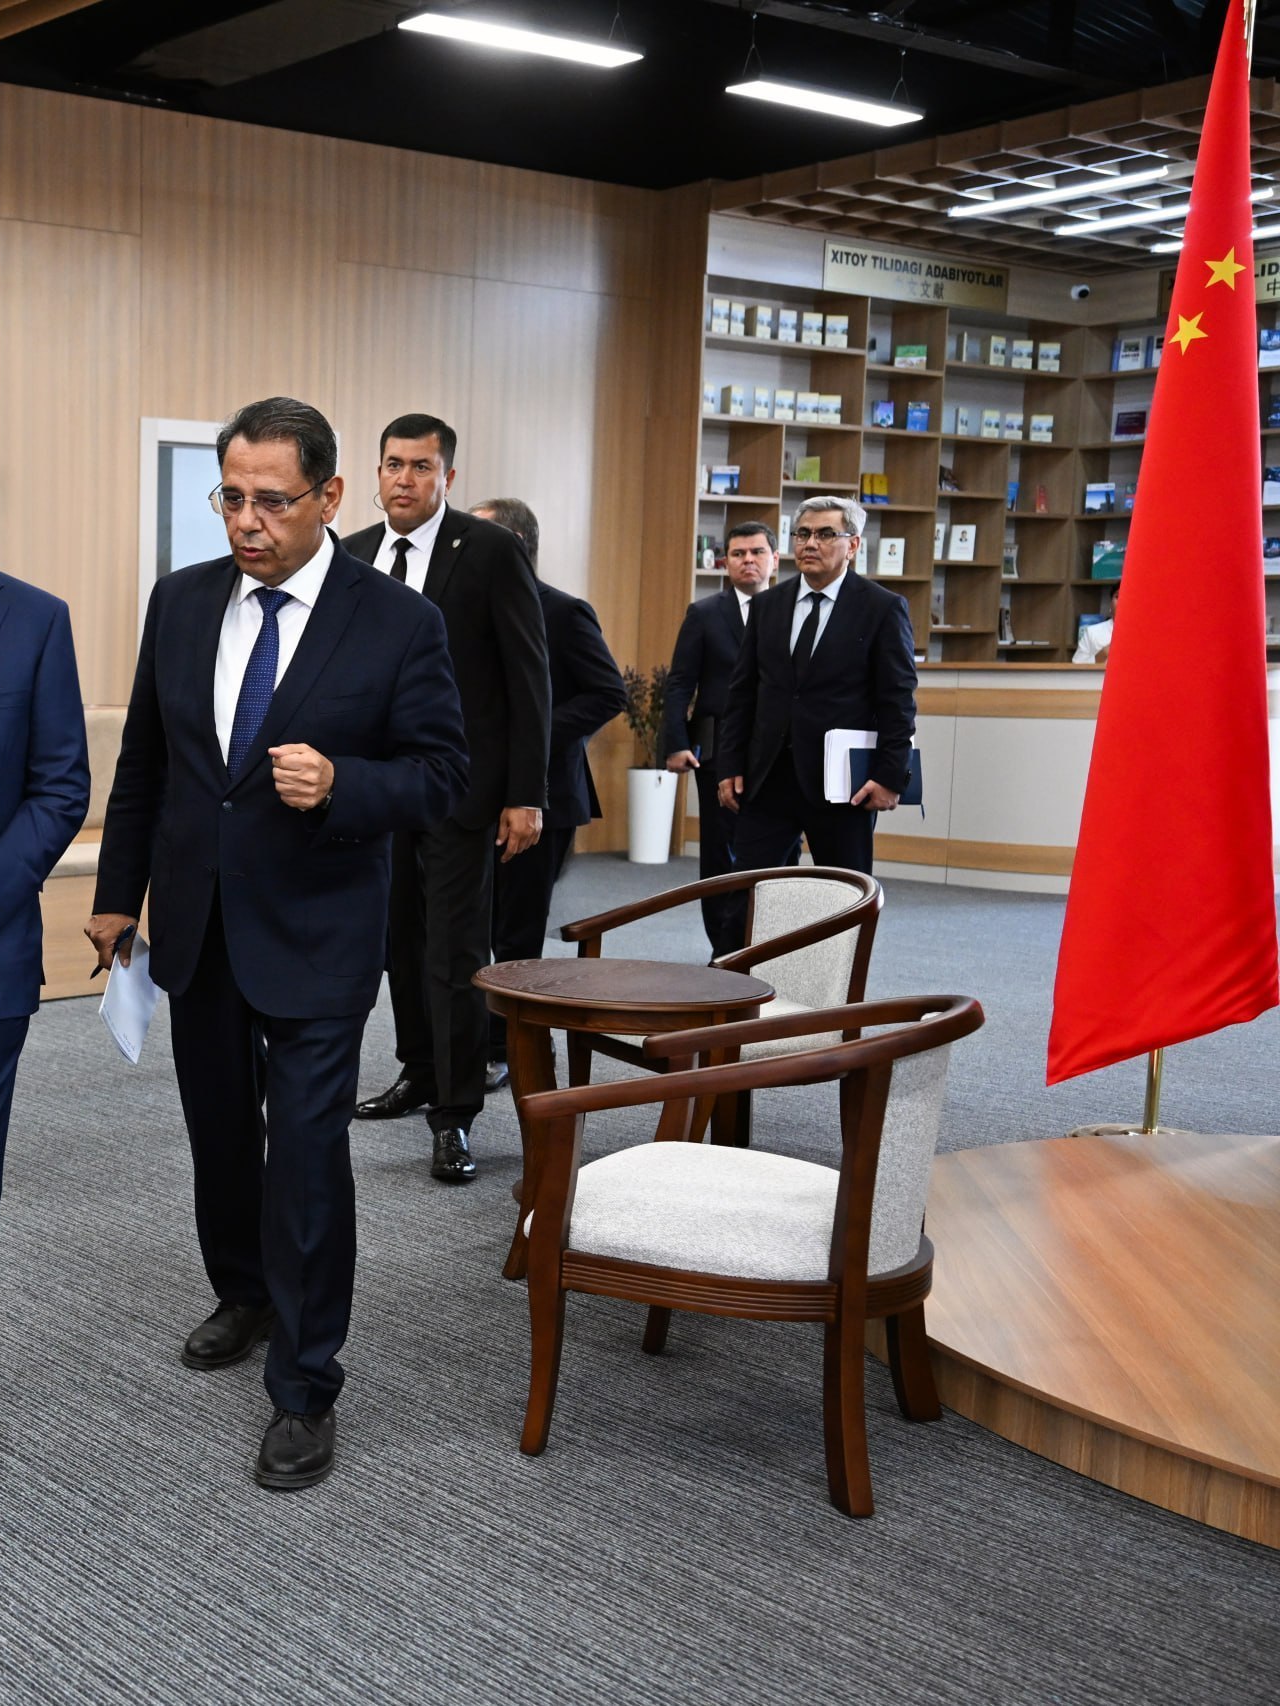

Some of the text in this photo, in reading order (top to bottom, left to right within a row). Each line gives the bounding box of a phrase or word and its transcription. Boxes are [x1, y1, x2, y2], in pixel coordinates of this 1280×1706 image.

[831, 249, 1004, 288] XITOY TILIDAGI ADABIYOTLAR
[1255, 262, 1280, 277] ID
